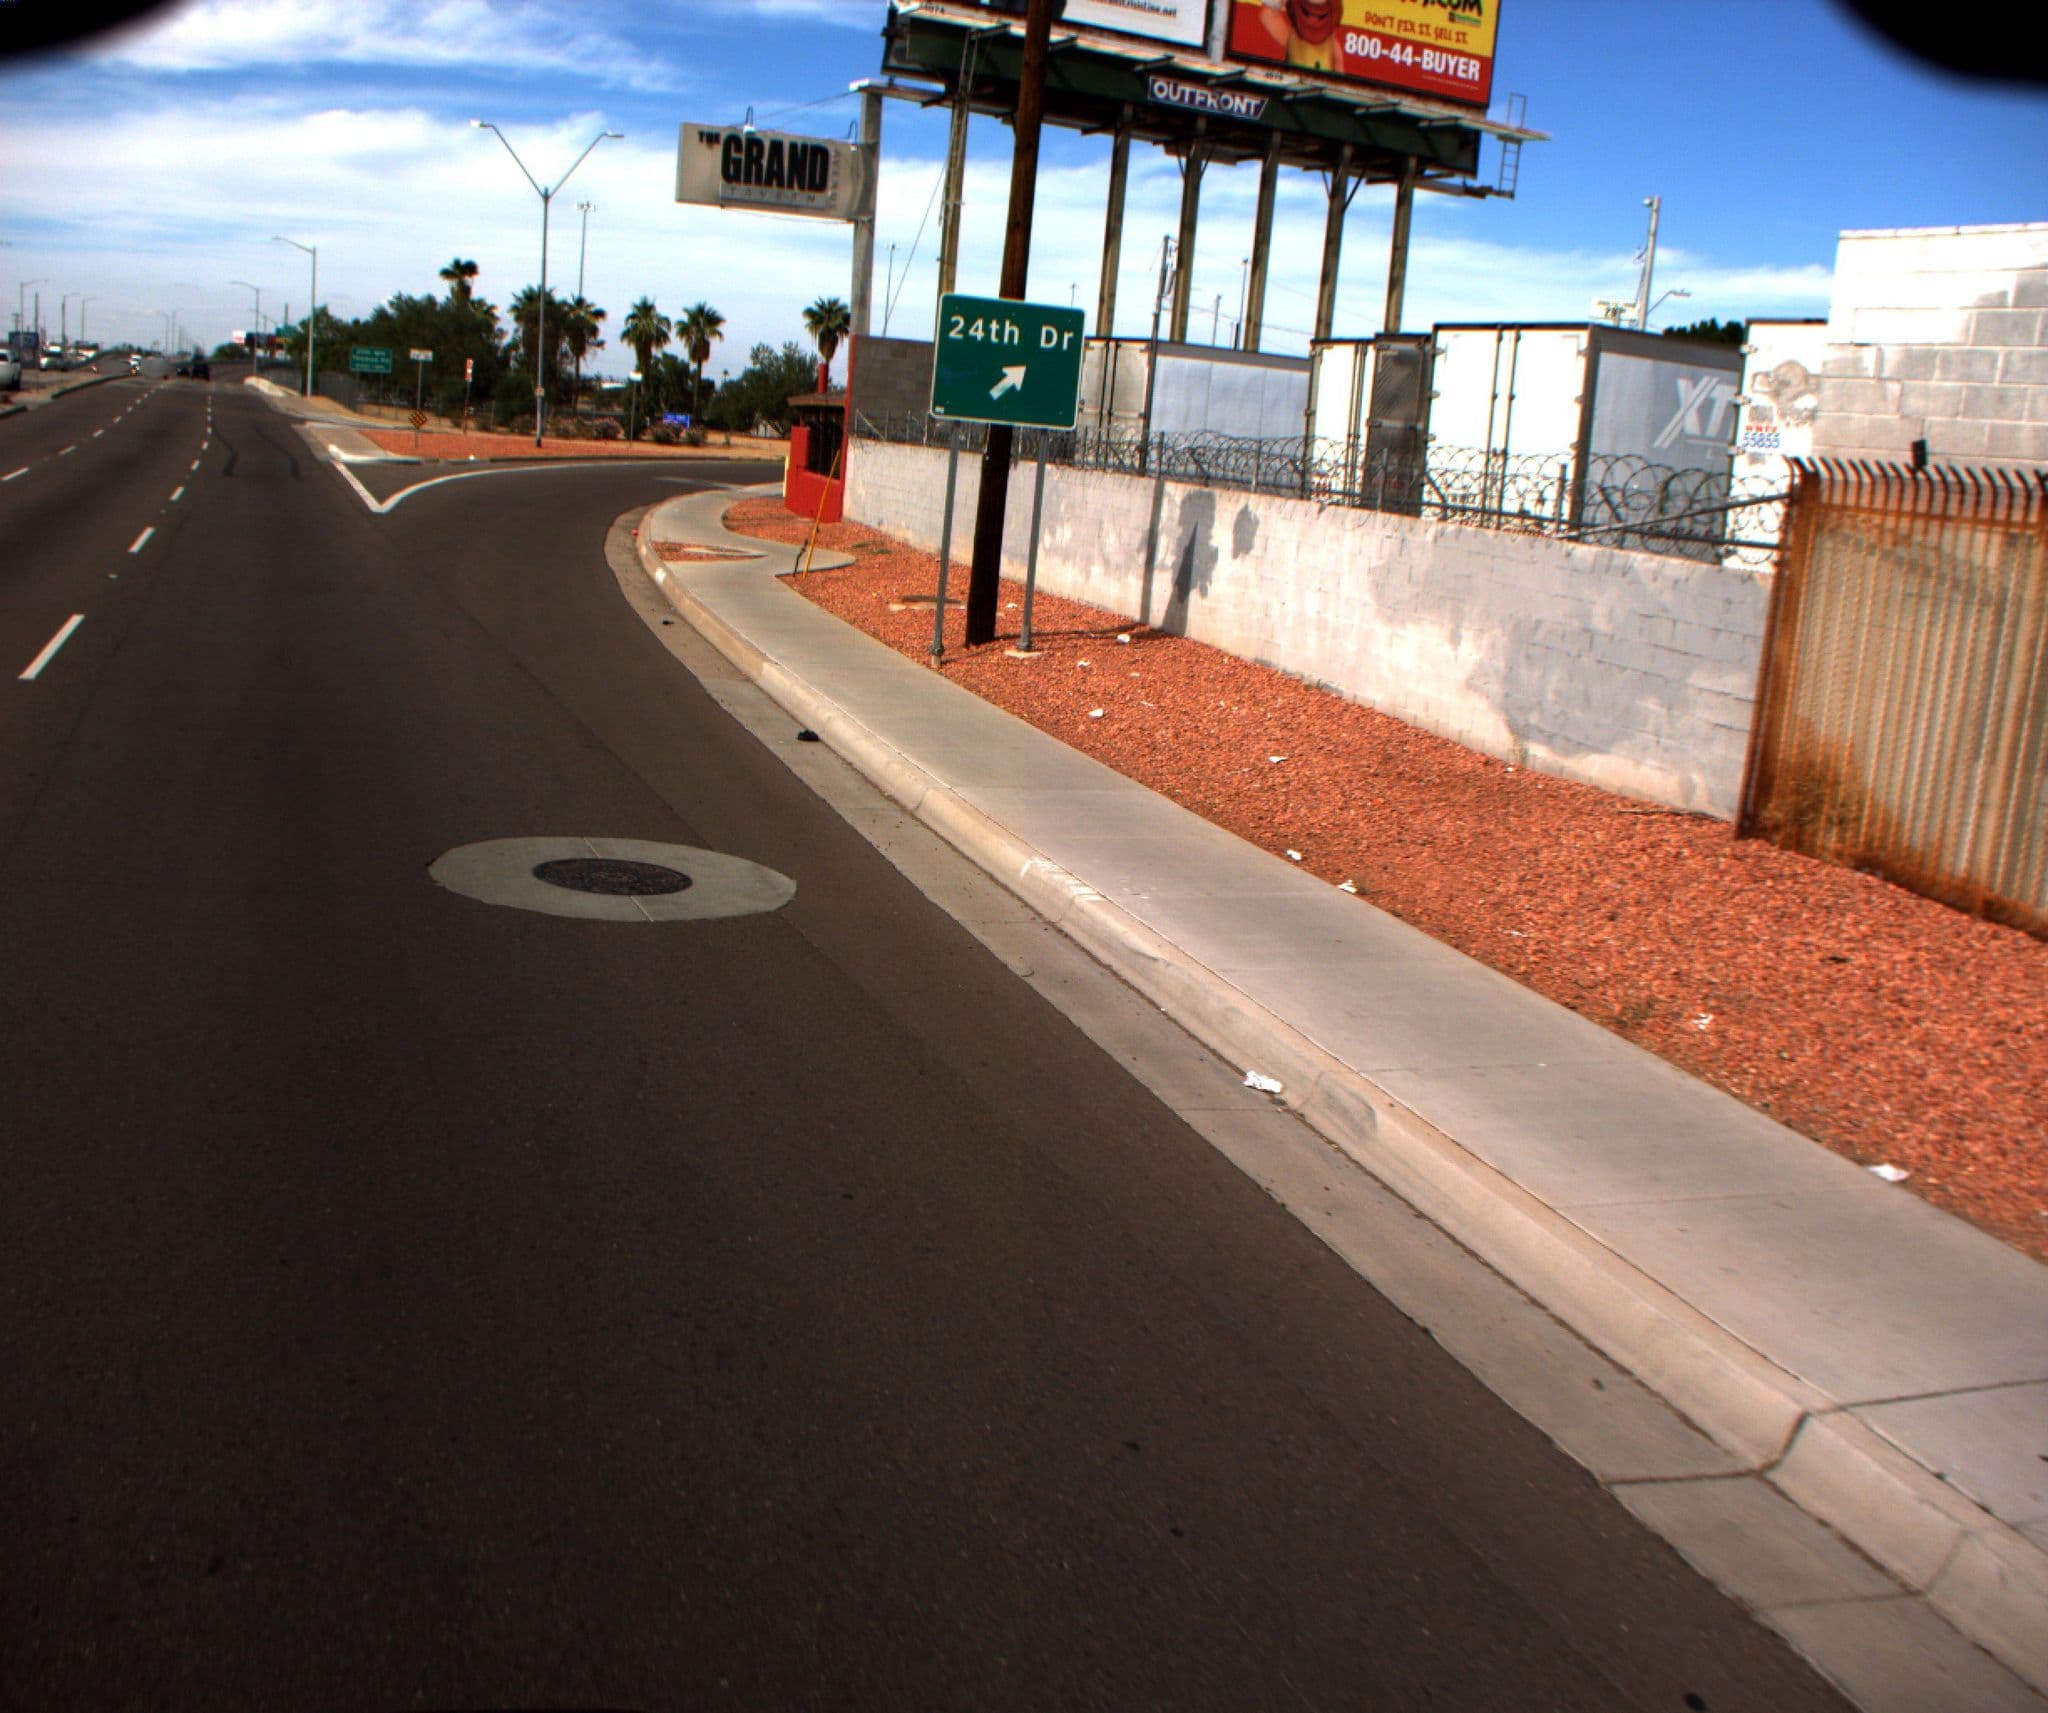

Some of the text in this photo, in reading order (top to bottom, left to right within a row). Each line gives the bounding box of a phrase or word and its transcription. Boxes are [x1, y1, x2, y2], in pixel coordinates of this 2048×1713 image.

[1344, 32, 1481, 82] 800-44-BUYER
[1152, 79, 1262, 116] OUTFRONT
[721, 133, 830, 194] GRAND
[948, 316, 1075, 351] 24th Dr
